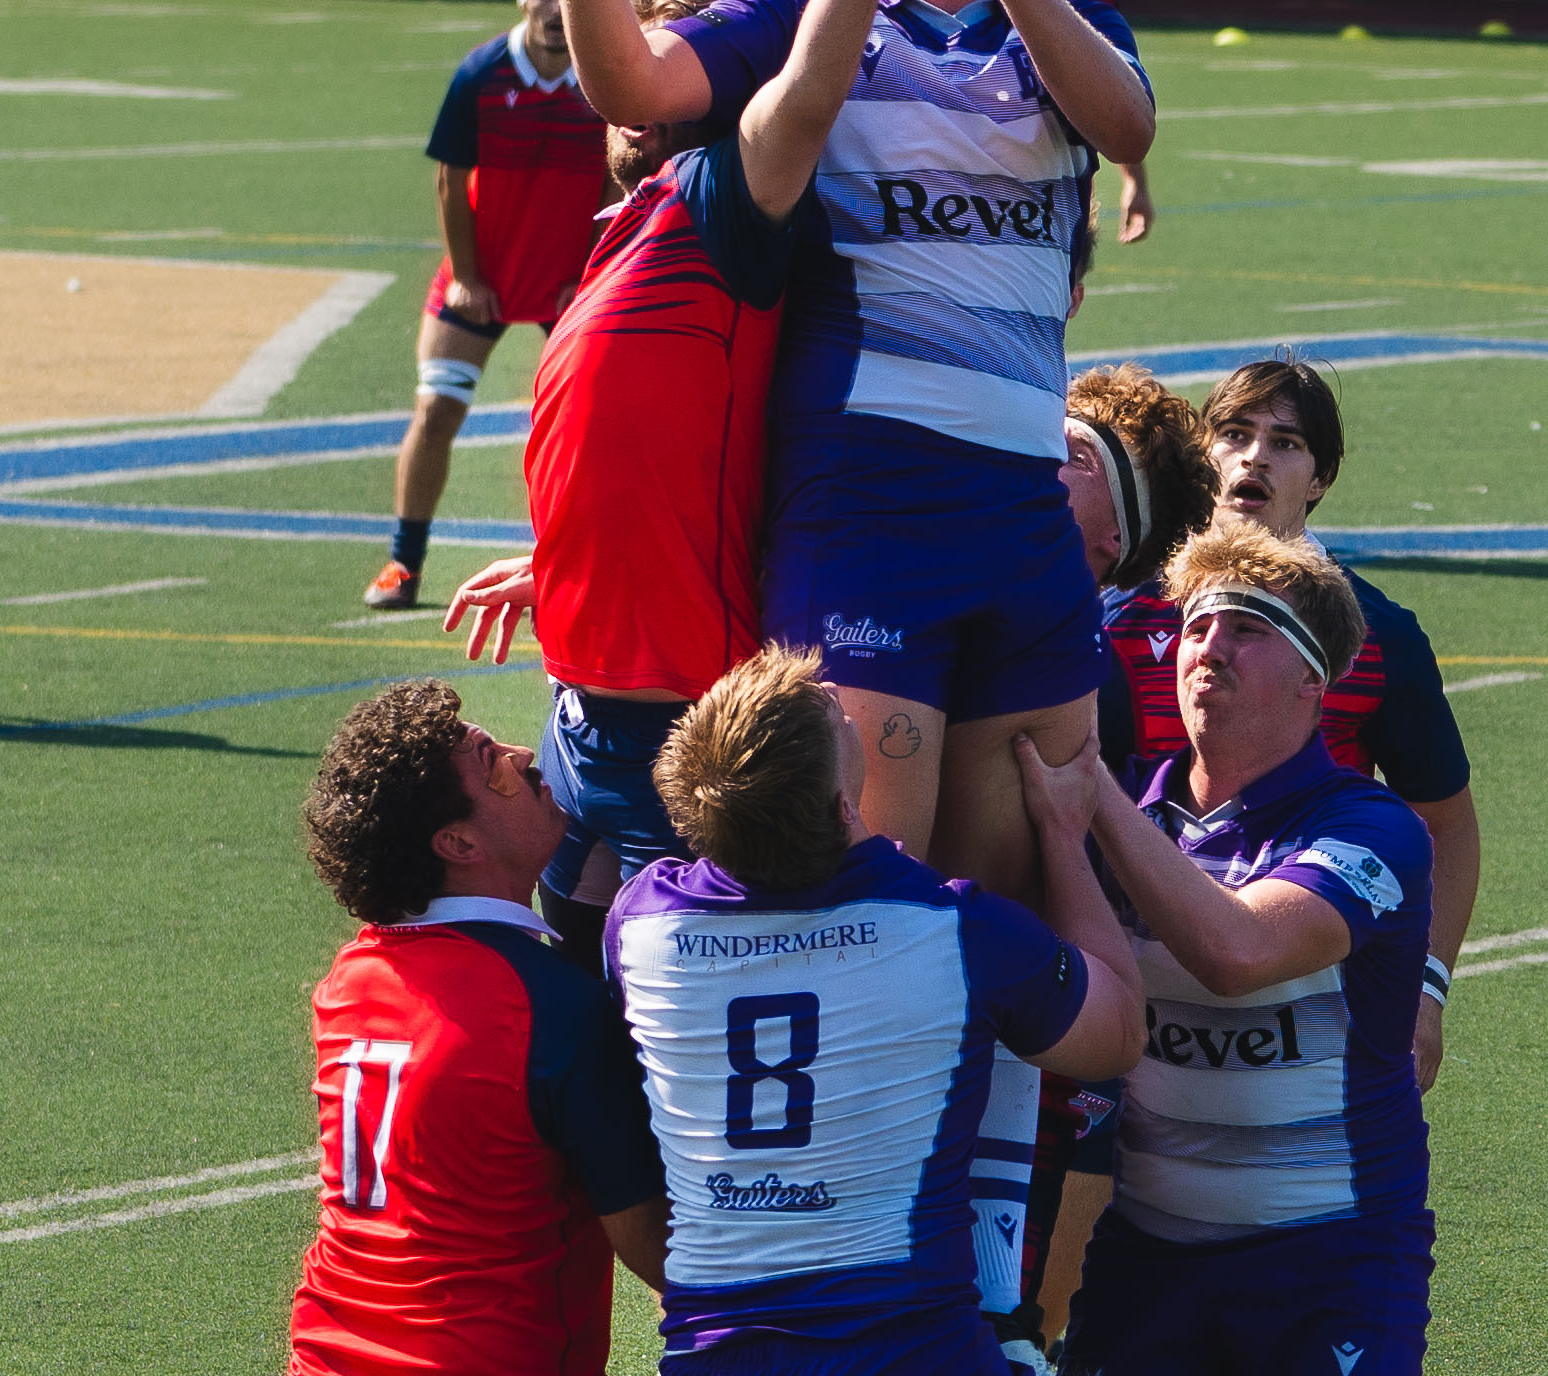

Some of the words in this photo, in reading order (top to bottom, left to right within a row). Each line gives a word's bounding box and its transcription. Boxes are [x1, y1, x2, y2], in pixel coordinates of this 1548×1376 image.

[874, 178, 1054, 243] Revel
[824, 613, 903, 650] Gaiters
[674, 921, 879, 958] WINDERMERE
[676, 947, 878, 973] CAPITAL
[725, 991, 820, 1150] 8
[340, 1039, 413, 1211] 17
[706, 1172, 837, 1212] Gaiters
